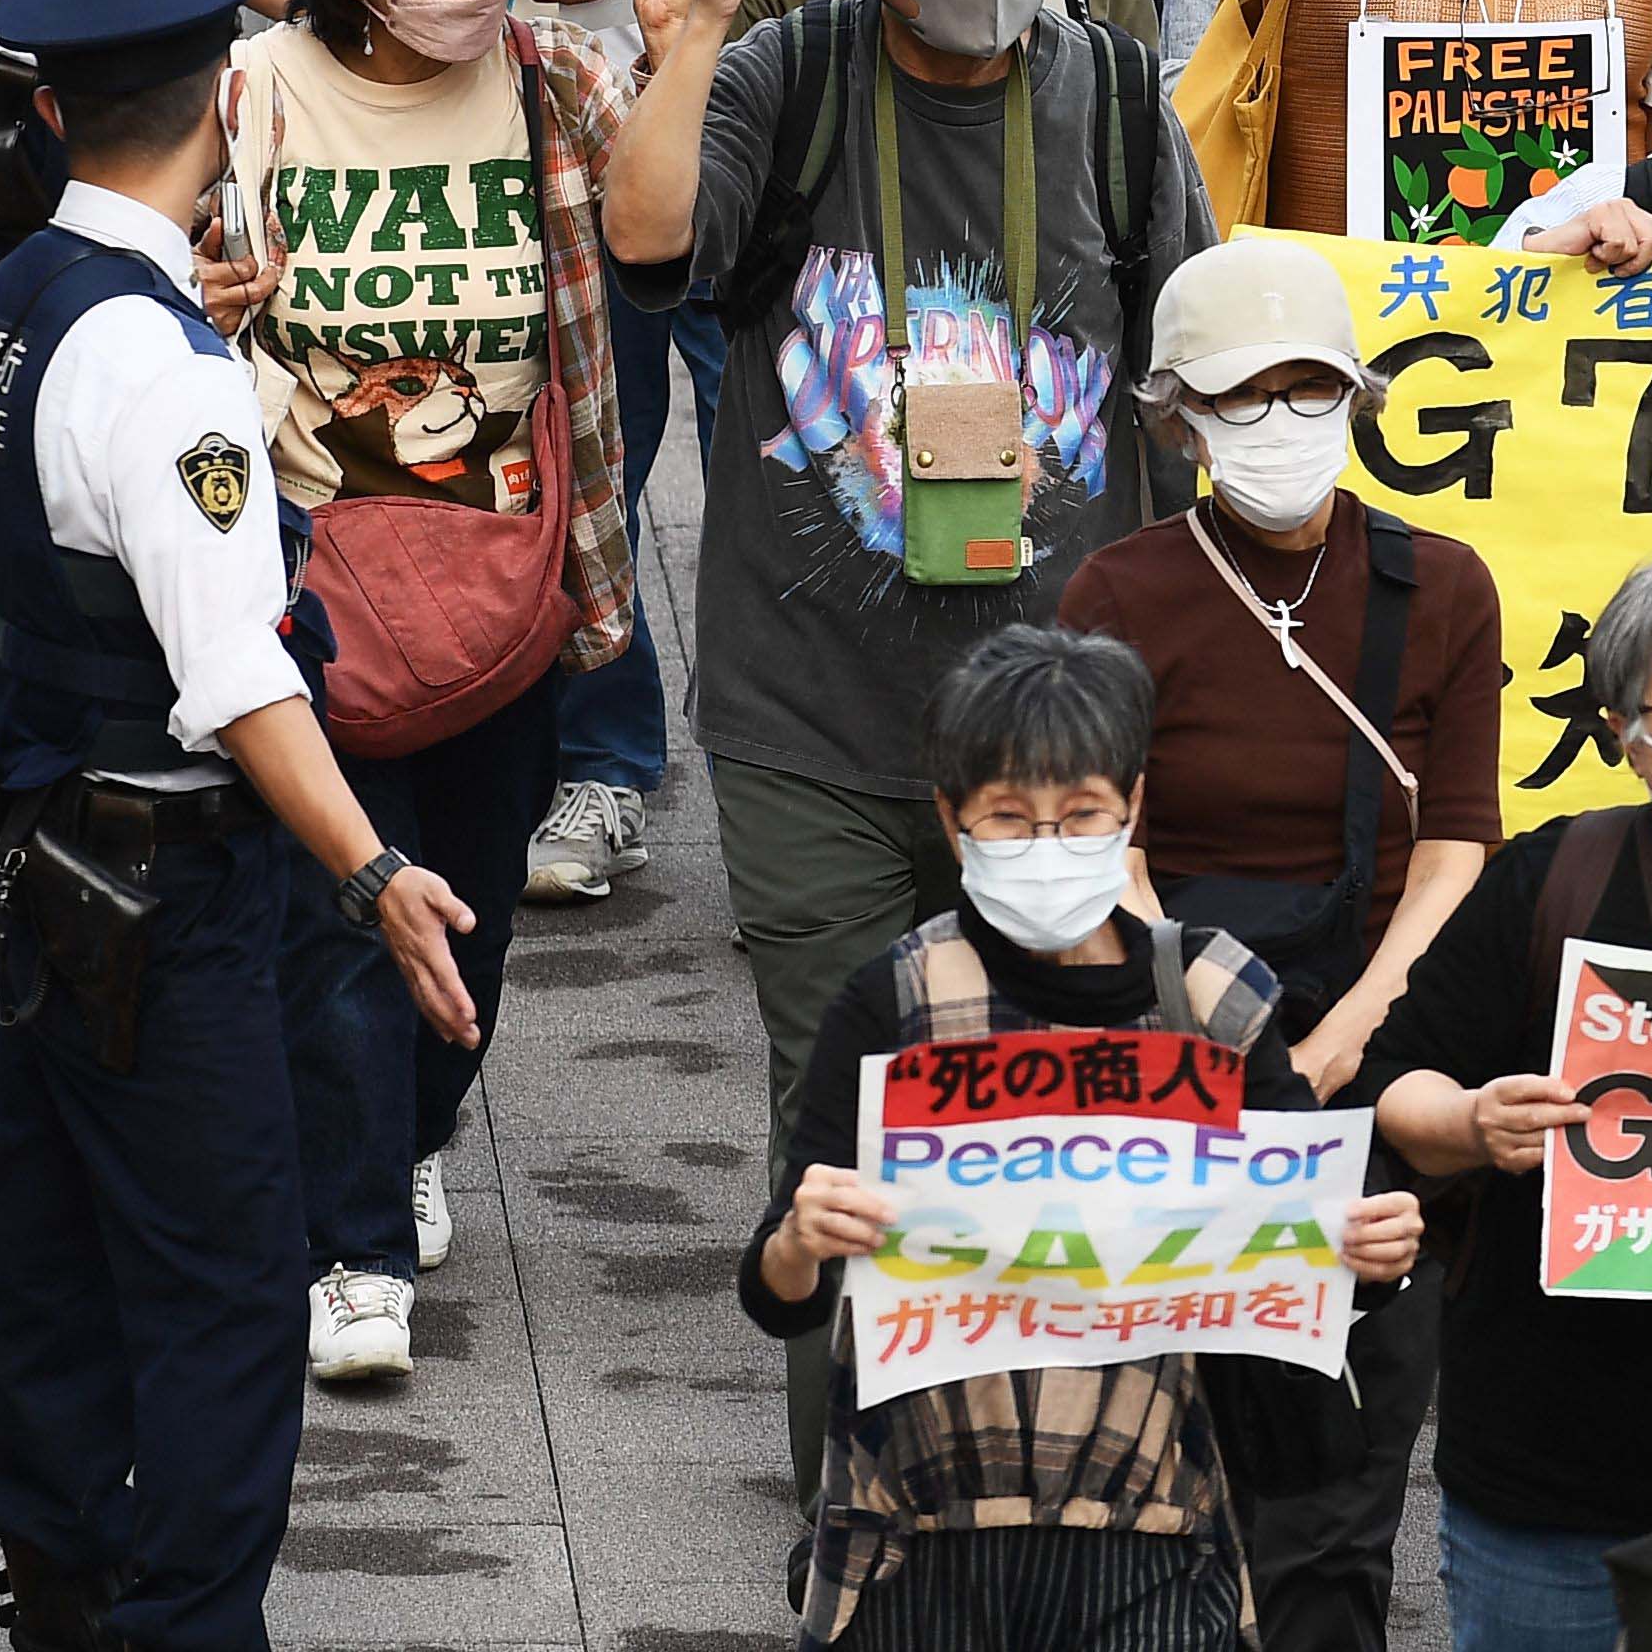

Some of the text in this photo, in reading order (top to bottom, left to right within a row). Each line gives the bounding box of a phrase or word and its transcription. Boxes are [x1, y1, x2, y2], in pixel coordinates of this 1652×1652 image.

[1398, 38, 1575, 82] FREE
[1388, 85, 1590, 139] PALESTINE
[276, 159, 545, 254] WAR
[289, 261, 545, 312] NOT TH
[880, 1127, 1344, 1187] Peace For
[871, 1199, 1343, 1290] GAZA
[876, 1280, 1328, 1364] ガザに平和を!
